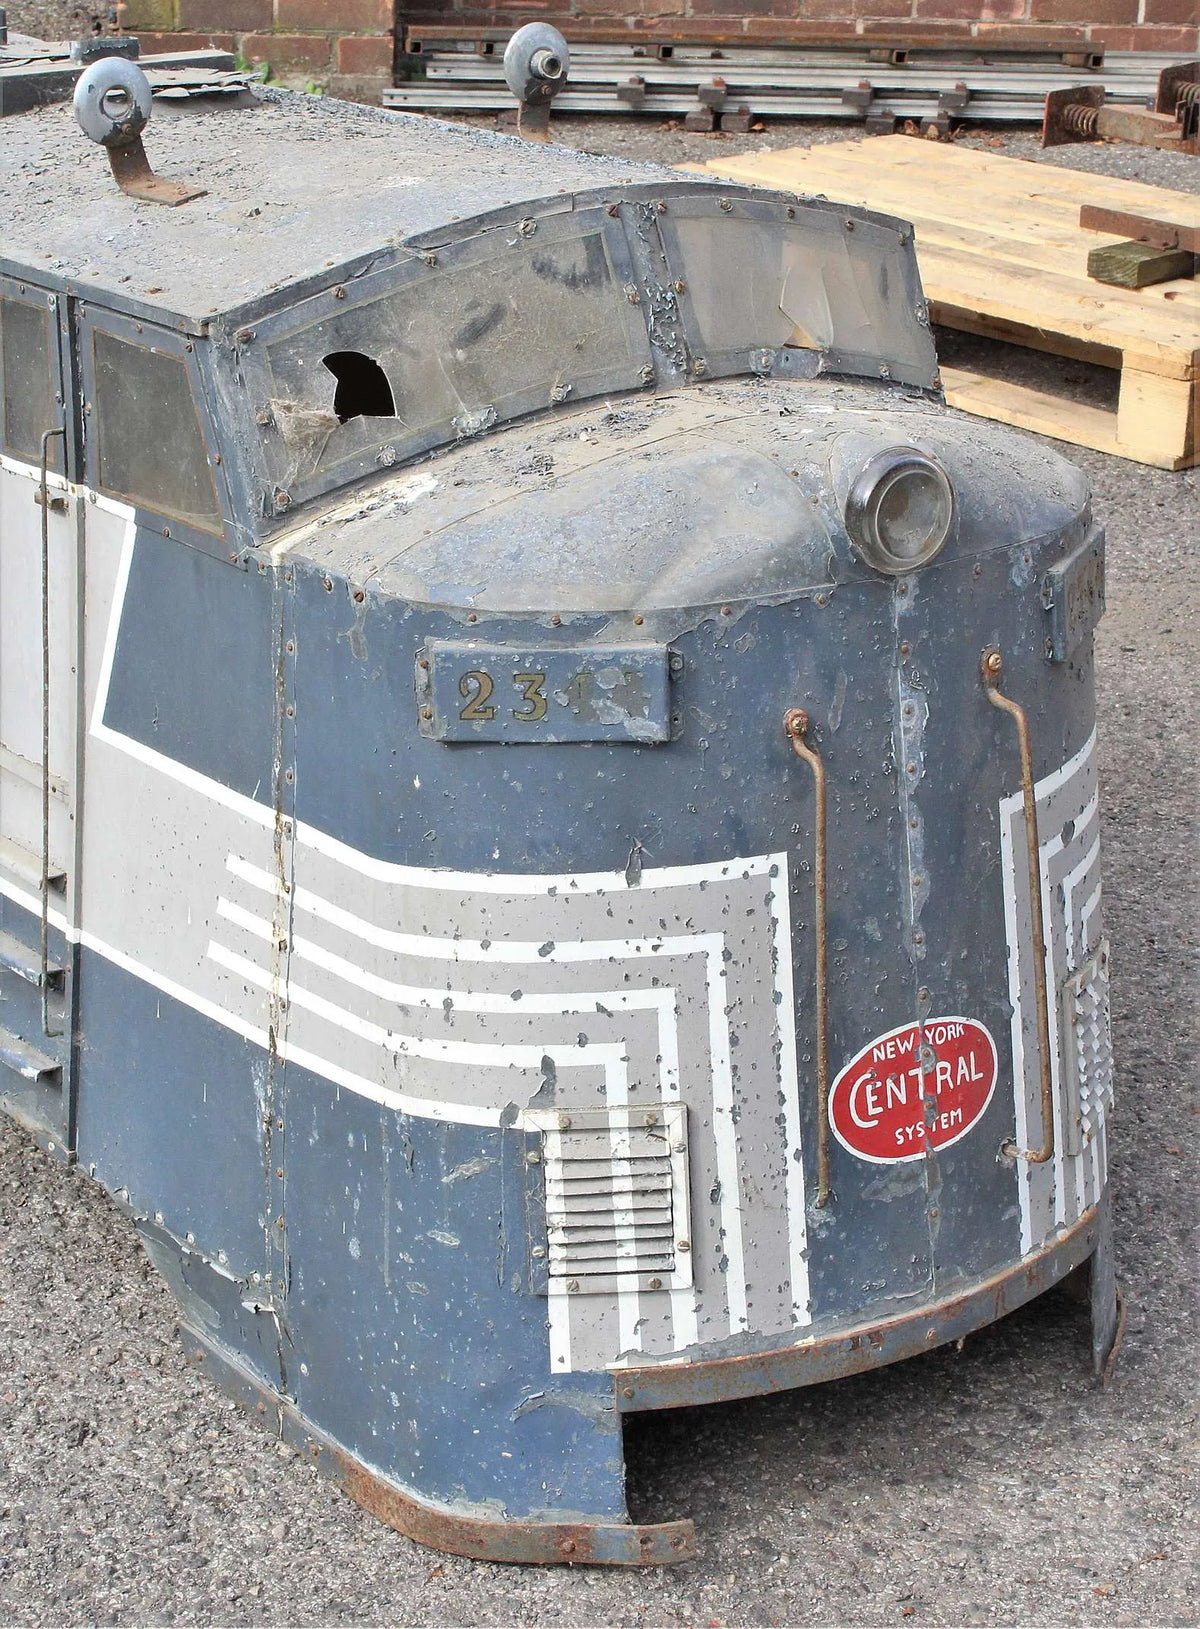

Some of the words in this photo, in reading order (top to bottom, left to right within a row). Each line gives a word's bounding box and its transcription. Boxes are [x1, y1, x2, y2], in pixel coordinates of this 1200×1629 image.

[873, 1032, 915, 1063] NEW
[924, 1023, 965, 1045] YORK
[849, 1051, 984, 1128] CENTRAL
